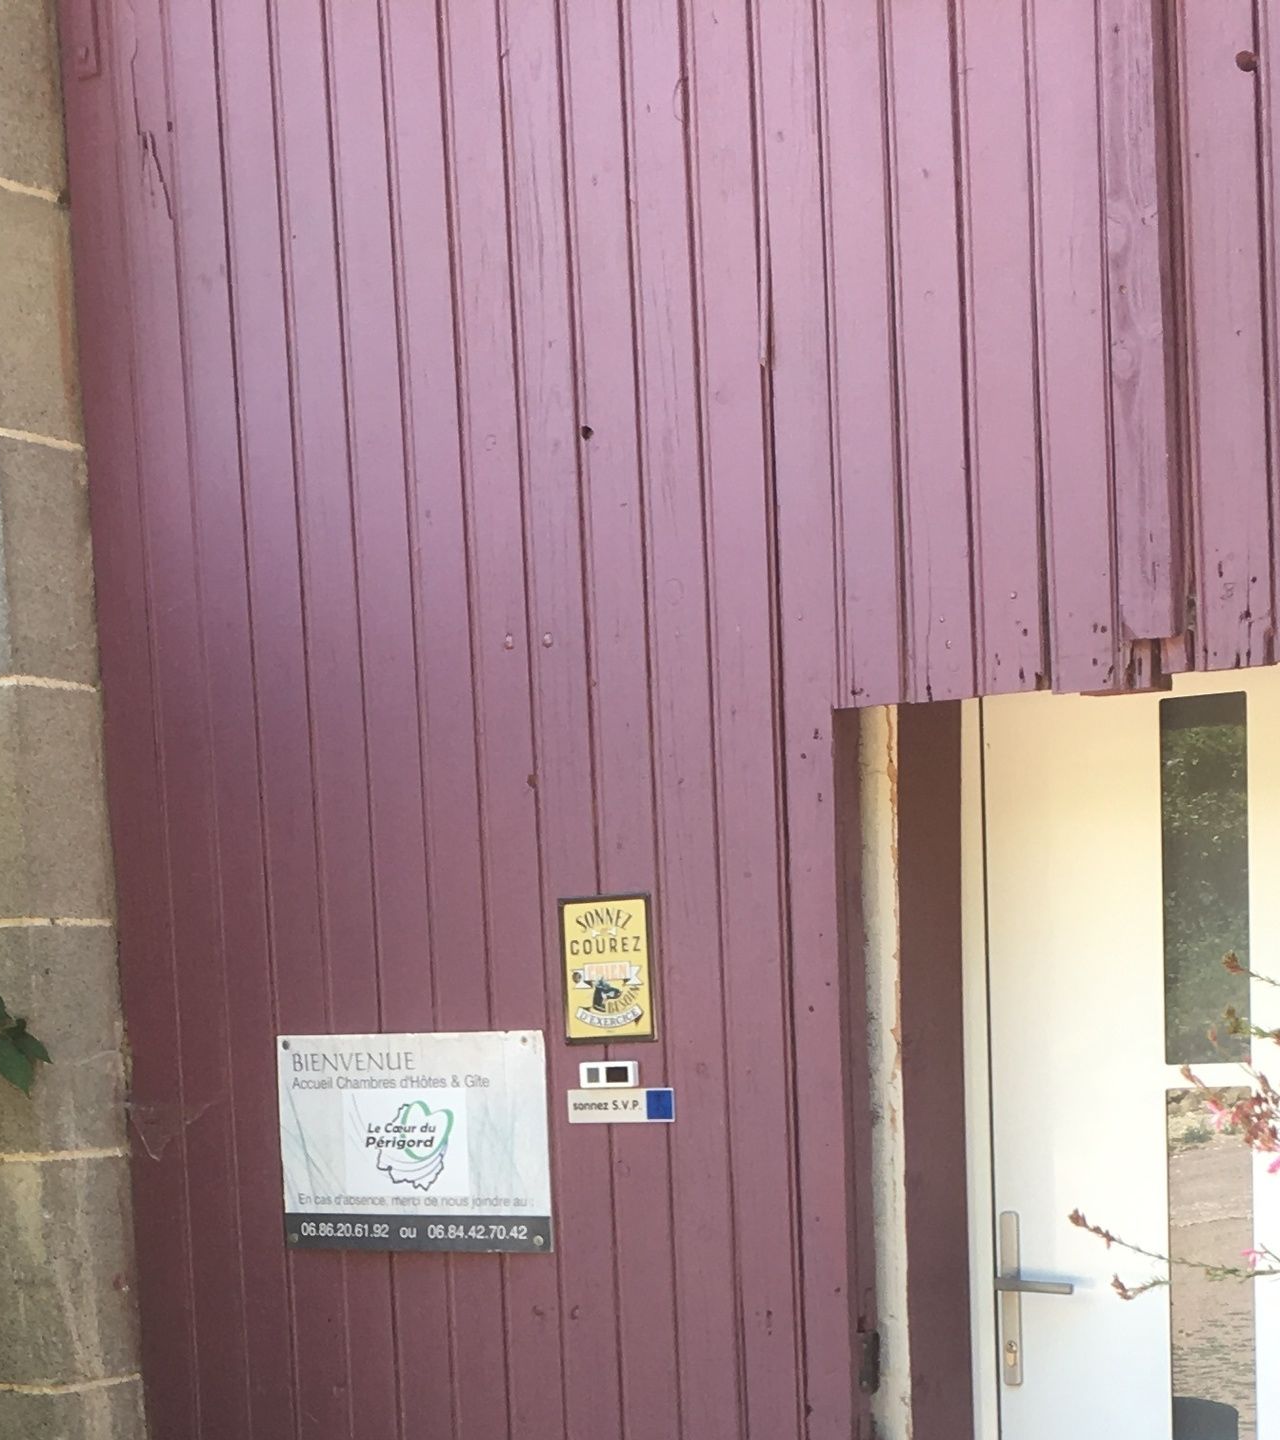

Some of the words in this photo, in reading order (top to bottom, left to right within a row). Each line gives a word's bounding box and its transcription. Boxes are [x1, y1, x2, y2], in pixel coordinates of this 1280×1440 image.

[576, 907, 633, 932] SONNEZ
[570, 936, 641, 955] COUREZ
[579, 1009, 640, 1028] D'EXERCICE
[292, 1051, 416, 1071] BIENVENUE
[292, 1076, 333, 1089] Accueil
[336, 1076, 395, 1089] Chambres
[399, 1075, 447, 1088] d'Hôtes
[451, 1075, 460, 1088] &
[464, 1075, 490, 1088] Gîte
[573, 1100, 608, 1111] sonnez
[367, 1123, 381, 1134] Le
[420, 1122, 436, 1134] du
[365, 1136, 434, 1150] Périgord
[298, 1193, 312, 1205] En
[314, 1195, 332, 1206] cas
[392, 1195, 421, 1206] merci
[424, 1196, 438, 1207] de
[441, 1197, 469, 1207] nous
[471, 1196, 511, 1210] joindre
[513, 1197, 527, 1207] au
[301, 1222, 389, 1238] 06.86.20.61.92
[400, 1226, 417, 1239] ou
[427, 1223, 528, 1240] 06.84.42.70.42
